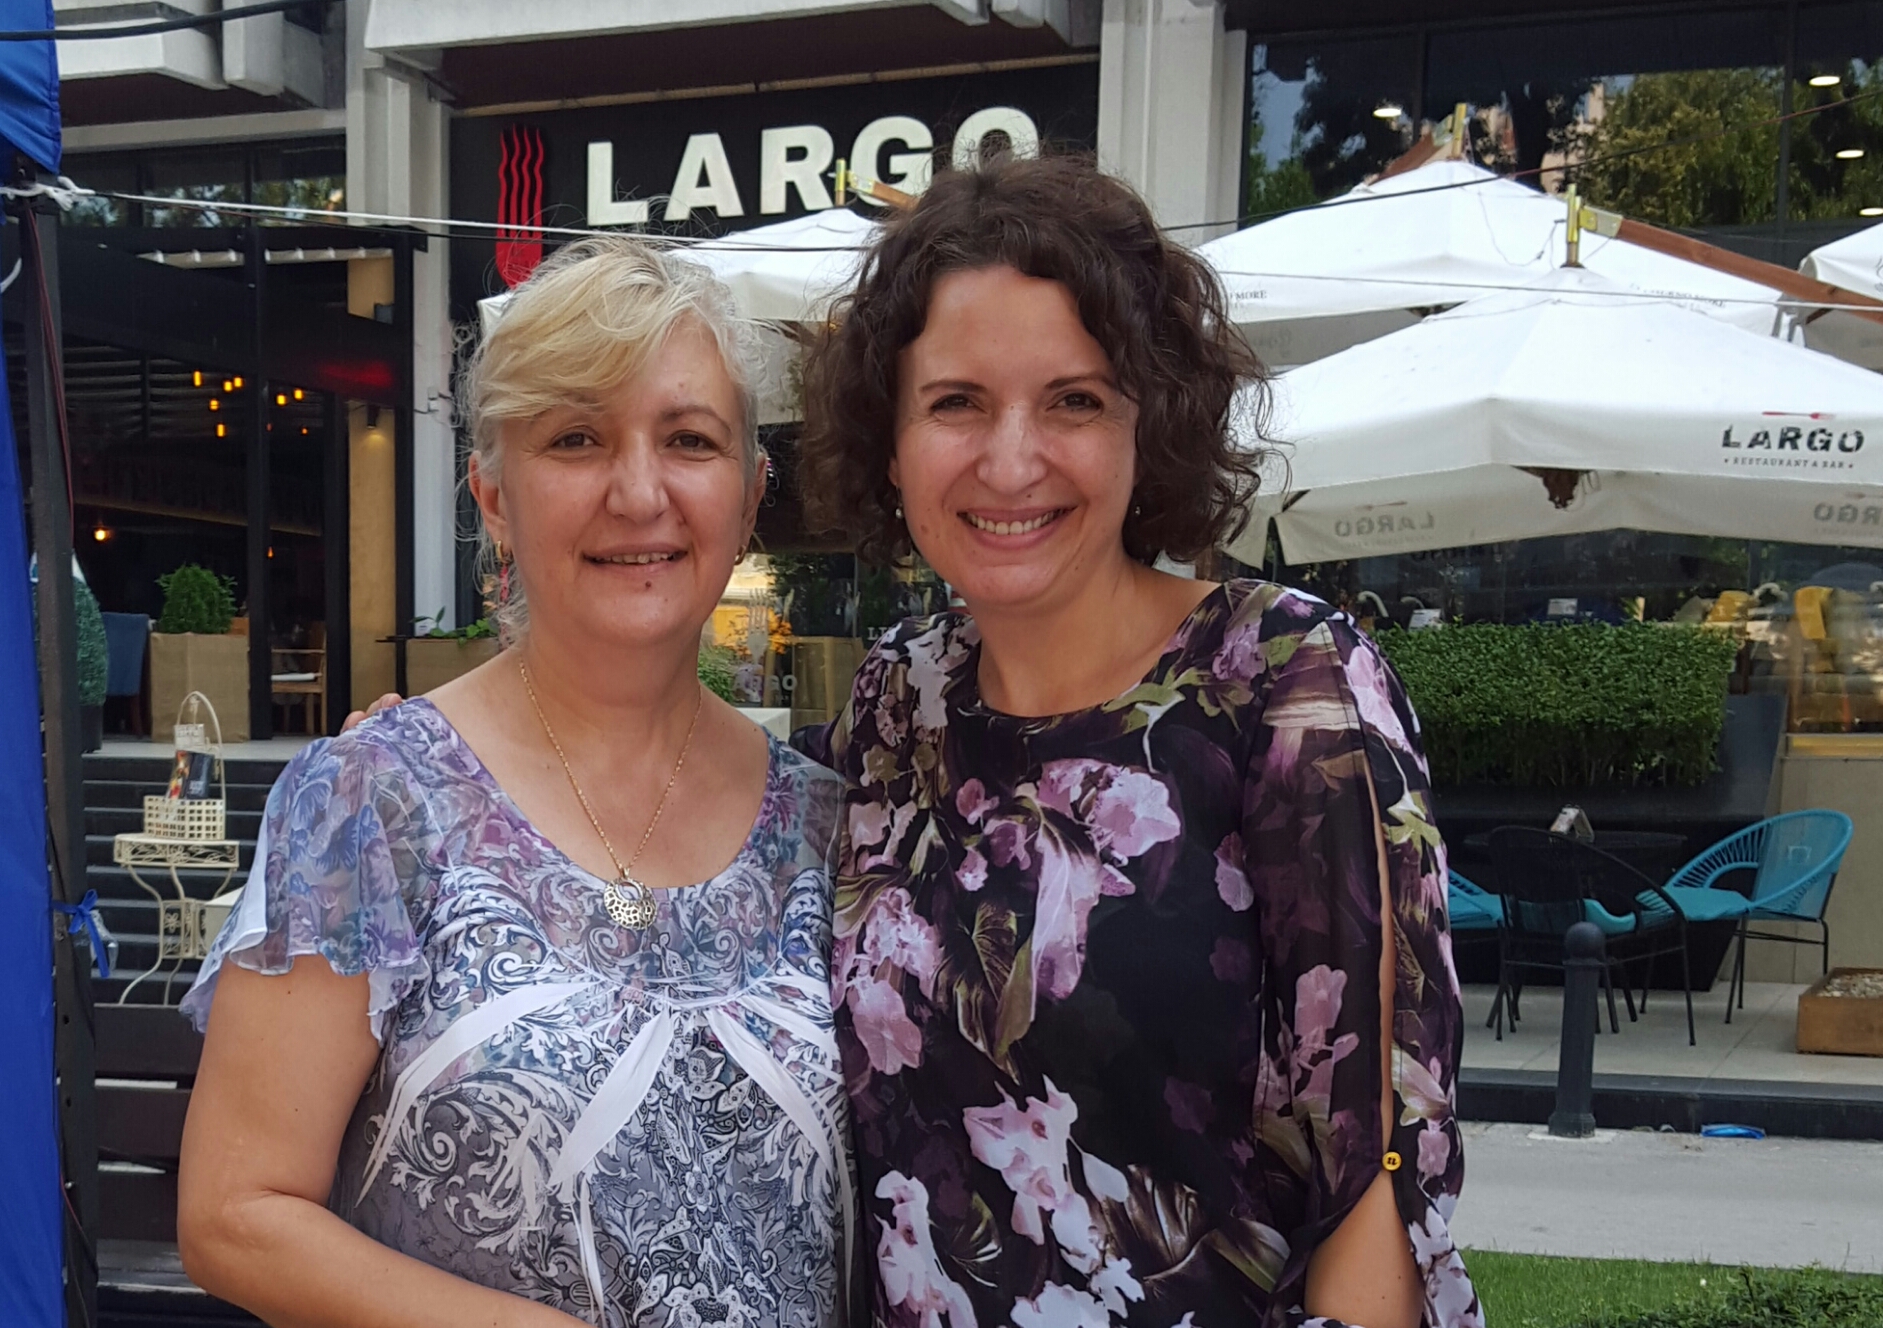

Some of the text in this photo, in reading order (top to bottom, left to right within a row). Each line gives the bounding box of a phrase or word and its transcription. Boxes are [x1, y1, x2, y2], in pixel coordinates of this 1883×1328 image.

[586, 106, 1041, 227] LARGO
[1721, 424, 1865, 453] LARGO
[1733, 457, 1808, 468] RESTAURANT
